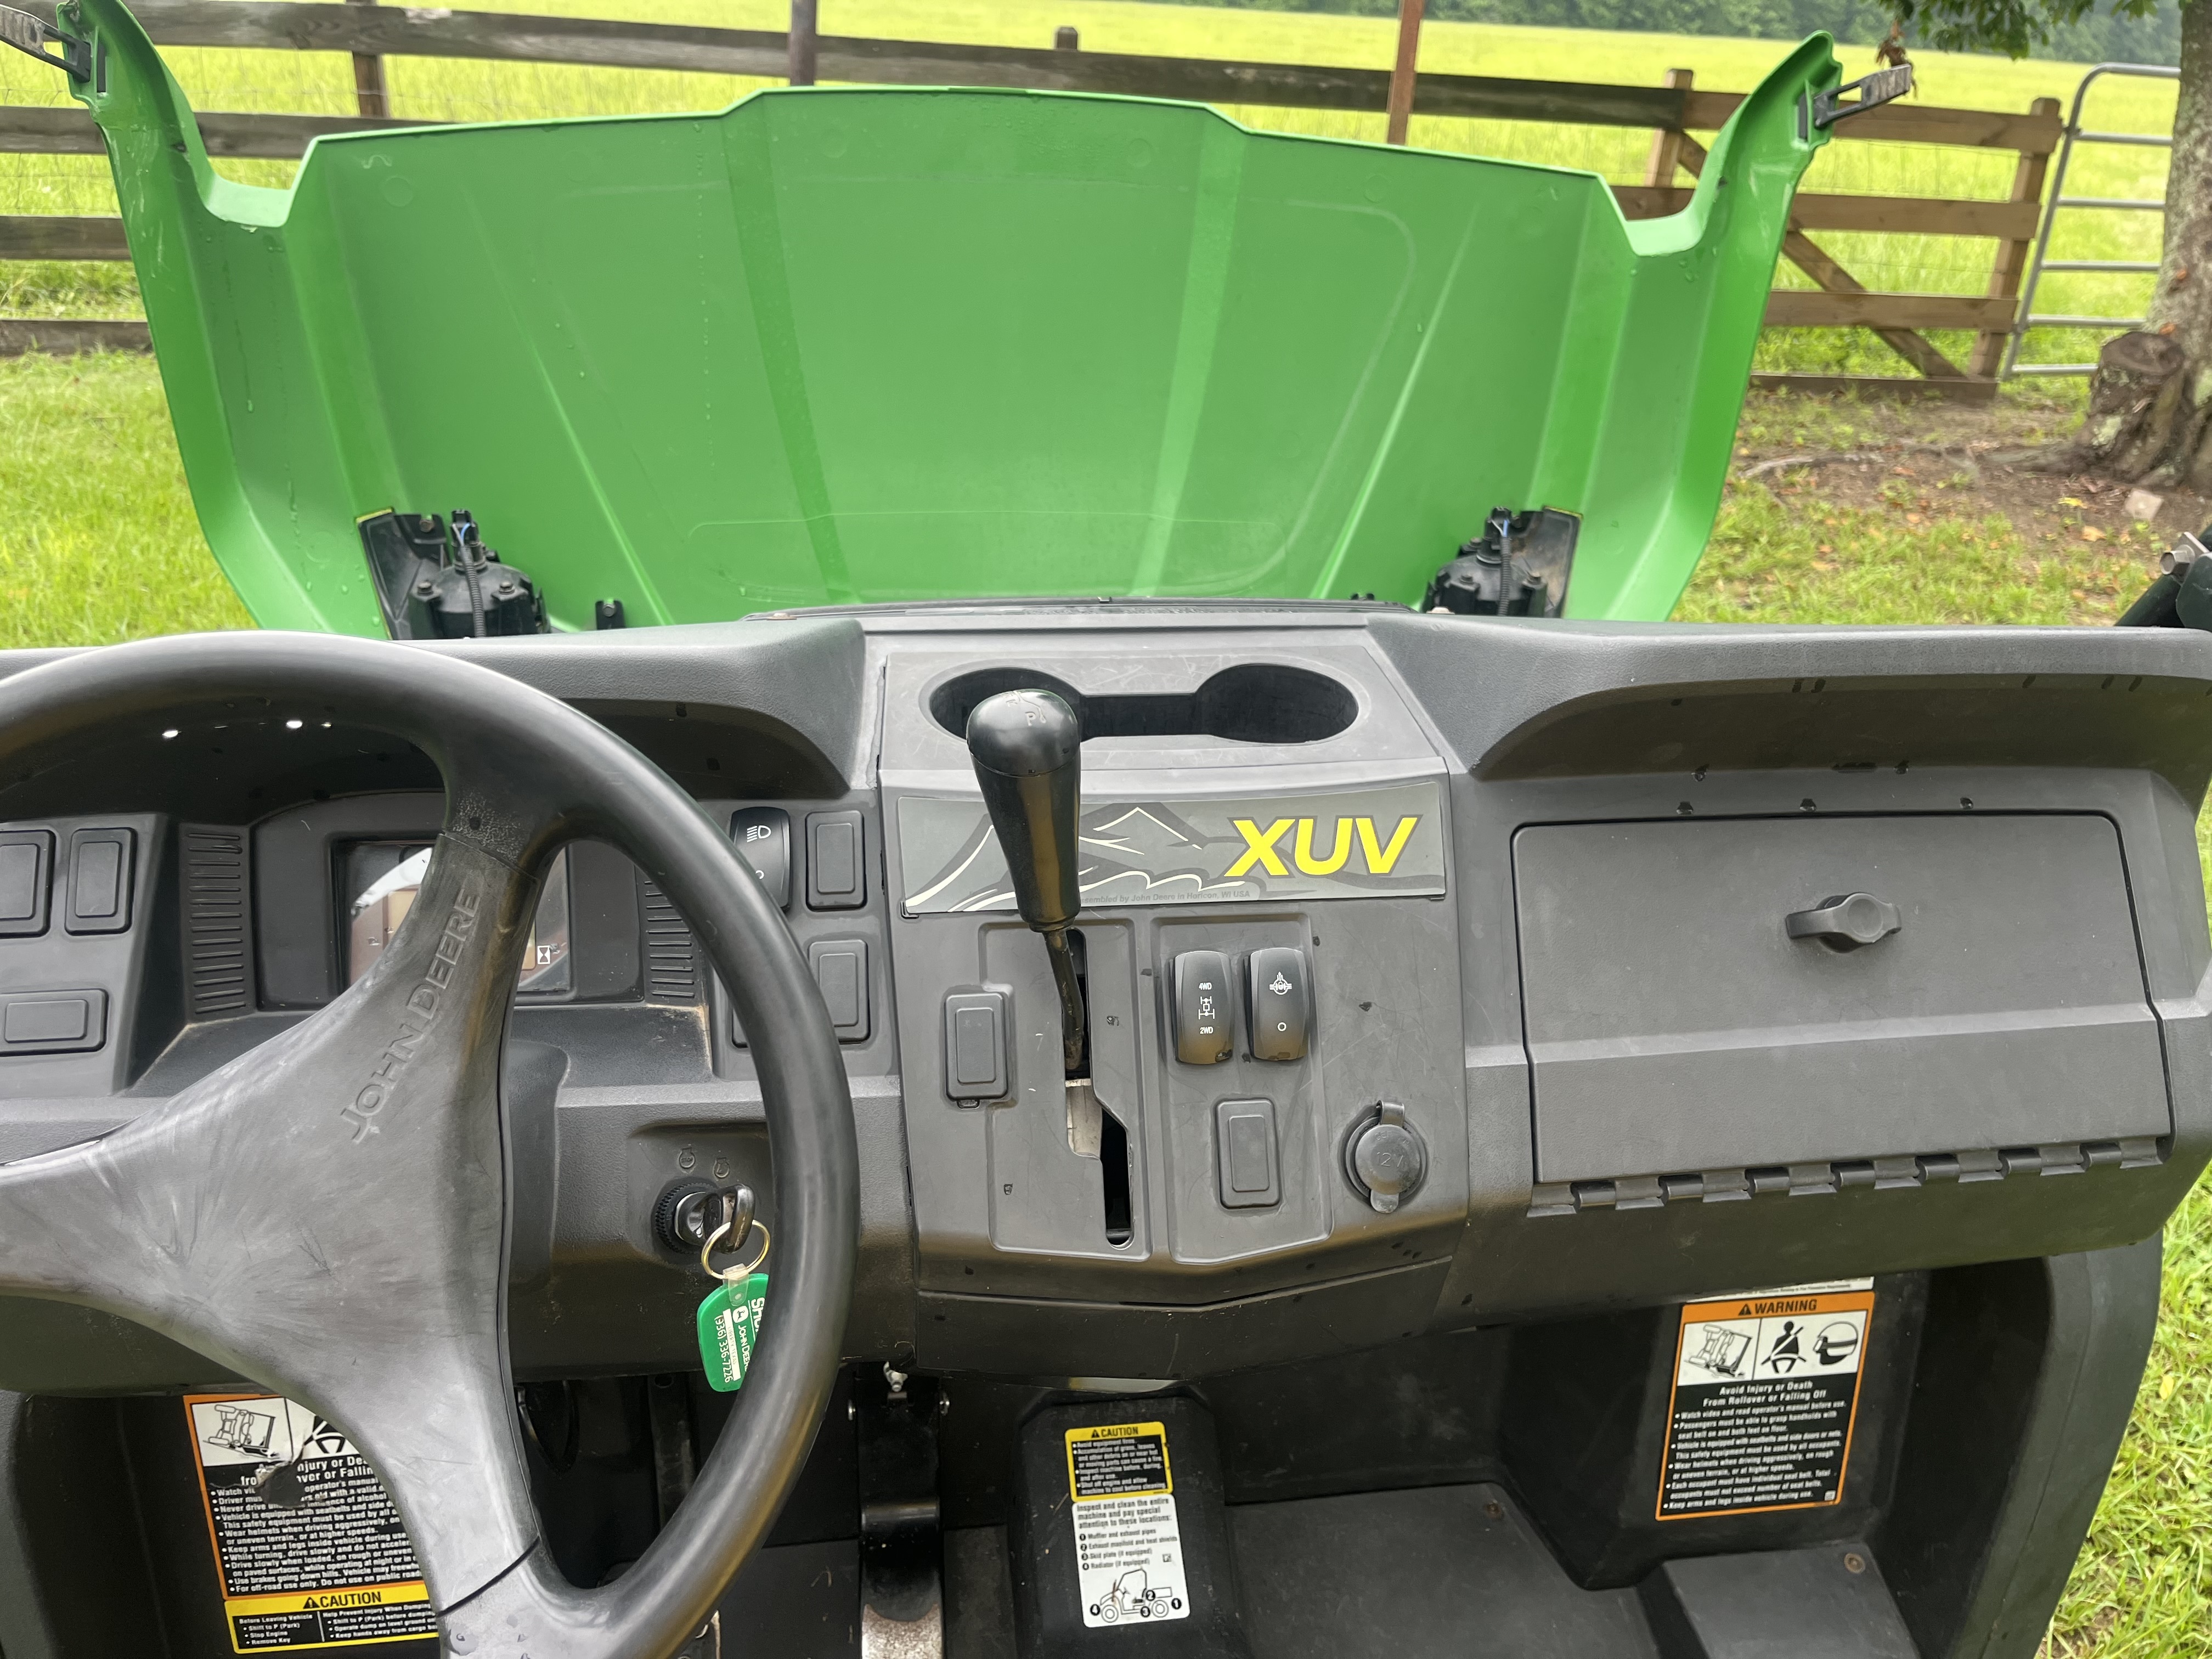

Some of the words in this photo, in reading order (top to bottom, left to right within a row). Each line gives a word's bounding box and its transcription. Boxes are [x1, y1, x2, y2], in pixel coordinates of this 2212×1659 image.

[1224, 817, 1417, 876] XUV
[1081, 895, 1118, 904] ssembled
[341, 1024, 425, 1144] JOHN
[406, 888, 481, 1020] DEERE
[1755, 1299, 1818, 1314] WARNING
[714, 1315, 727, 1339] (936)
[738, 1325, 748, 1346] JOHN
[719, 1340, 733, 1383] 336-7226
[1101, 1426, 1138, 1438] CAUTION
[297, 1461, 327, 1472] njury
[331, 1459, 343, 1467] or
[324, 1470, 336, 1479] or
[340, 1465, 373, 1477] Fallin
[320, 1591, 381, 1607] CAUTION
